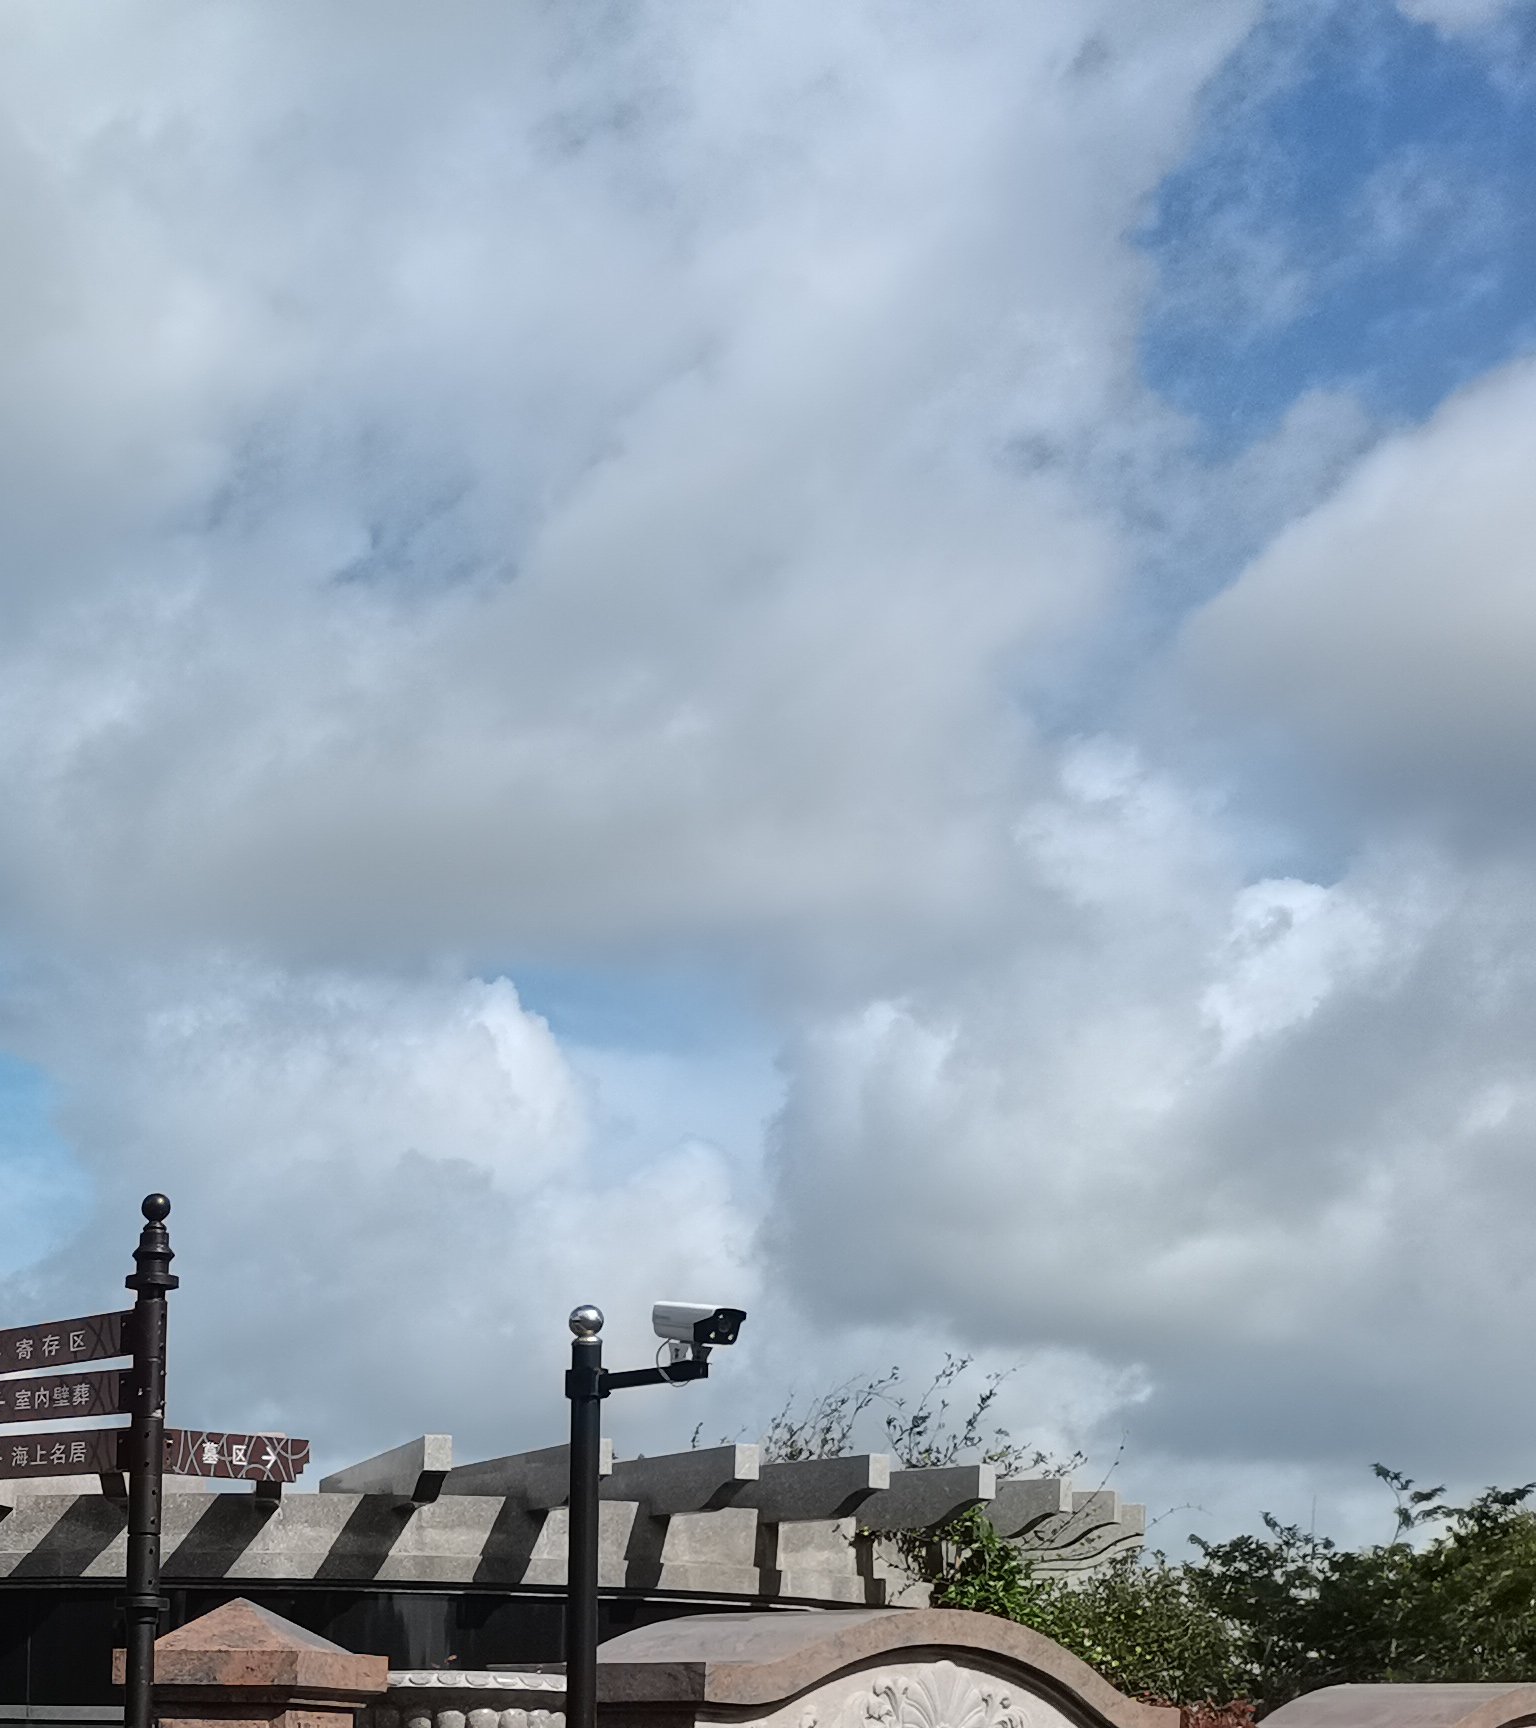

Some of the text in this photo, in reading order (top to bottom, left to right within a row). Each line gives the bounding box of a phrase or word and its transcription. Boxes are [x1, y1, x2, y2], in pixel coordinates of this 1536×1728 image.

[15, 1329, 88, 1362] 寄存区
[13, 1382, 91, 1411] 室内壁葬
[11, 1441, 88, 1467] 海上名居
[201, 1442, 249, 1466] 墓区
